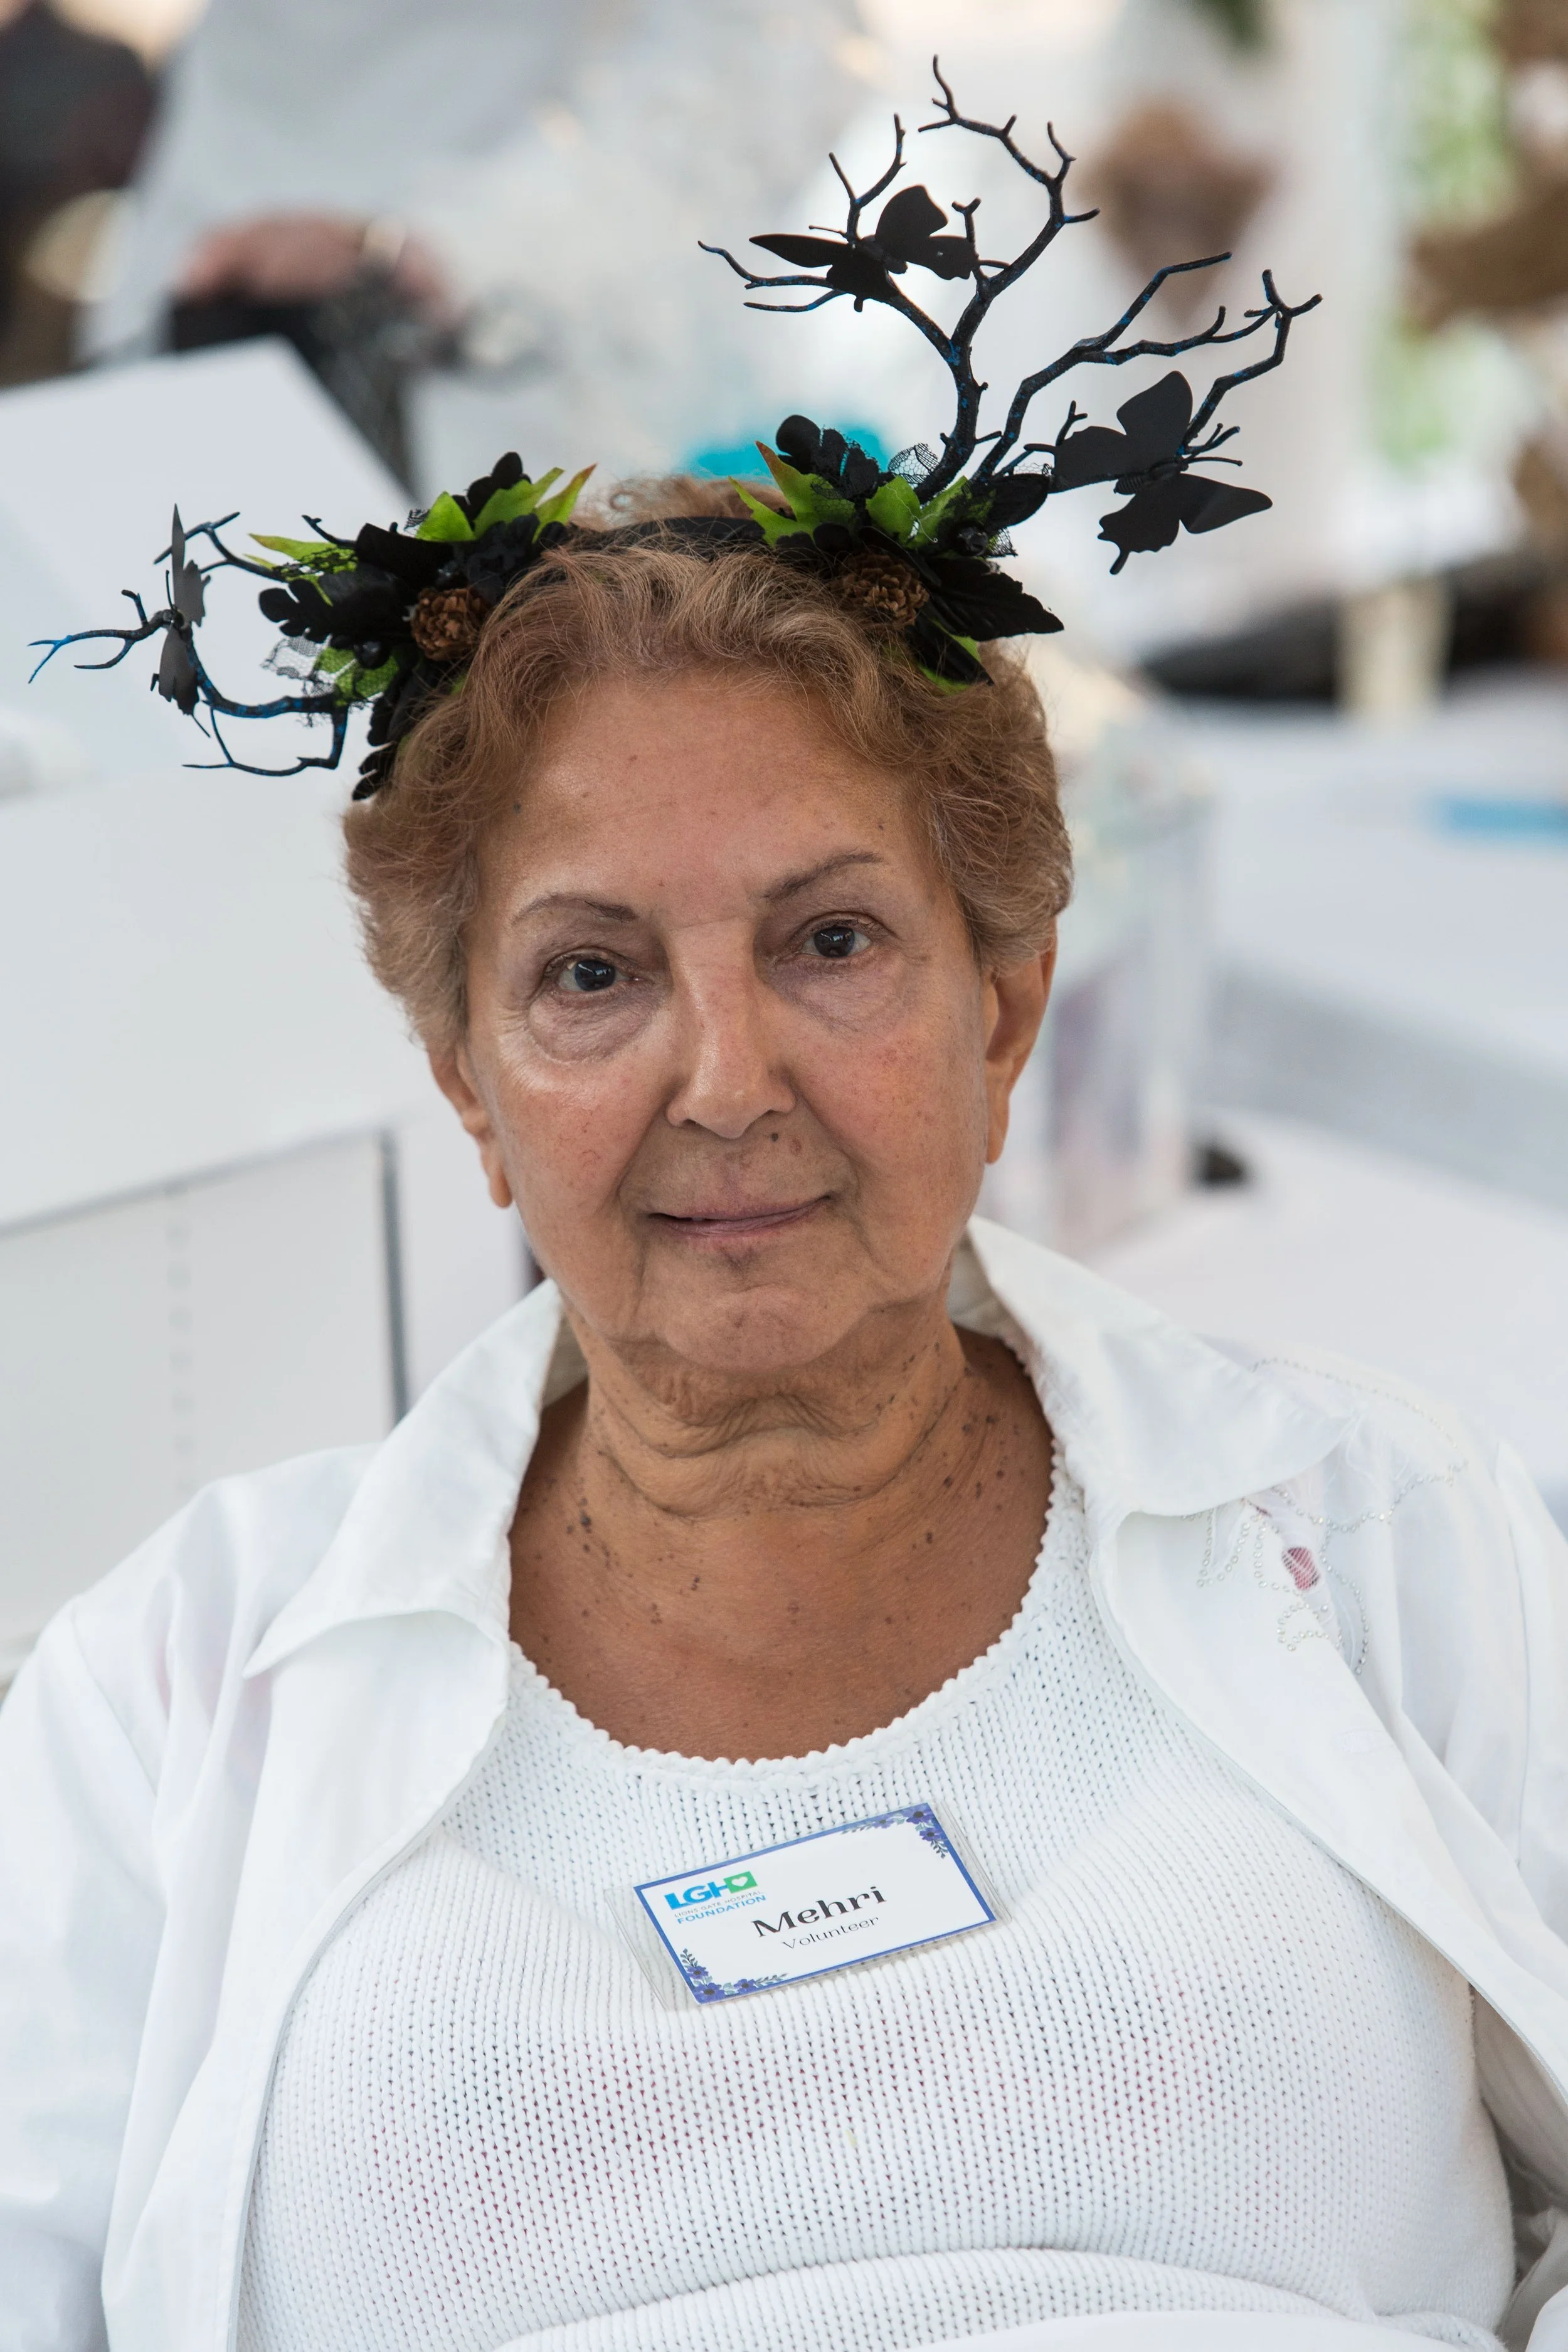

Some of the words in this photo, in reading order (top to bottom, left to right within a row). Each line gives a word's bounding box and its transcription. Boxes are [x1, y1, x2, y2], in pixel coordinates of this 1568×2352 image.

[674, 1909, 699, 1917] LIONS
[701, 1902, 722, 1910] GATE
[724, 1891, 763, 1904] HOSPITAL
[677, 1895, 766, 1924] FOUNDATION
[751, 1886, 887, 1937] Mehri
[781, 1916, 879, 1949] Volunteer
